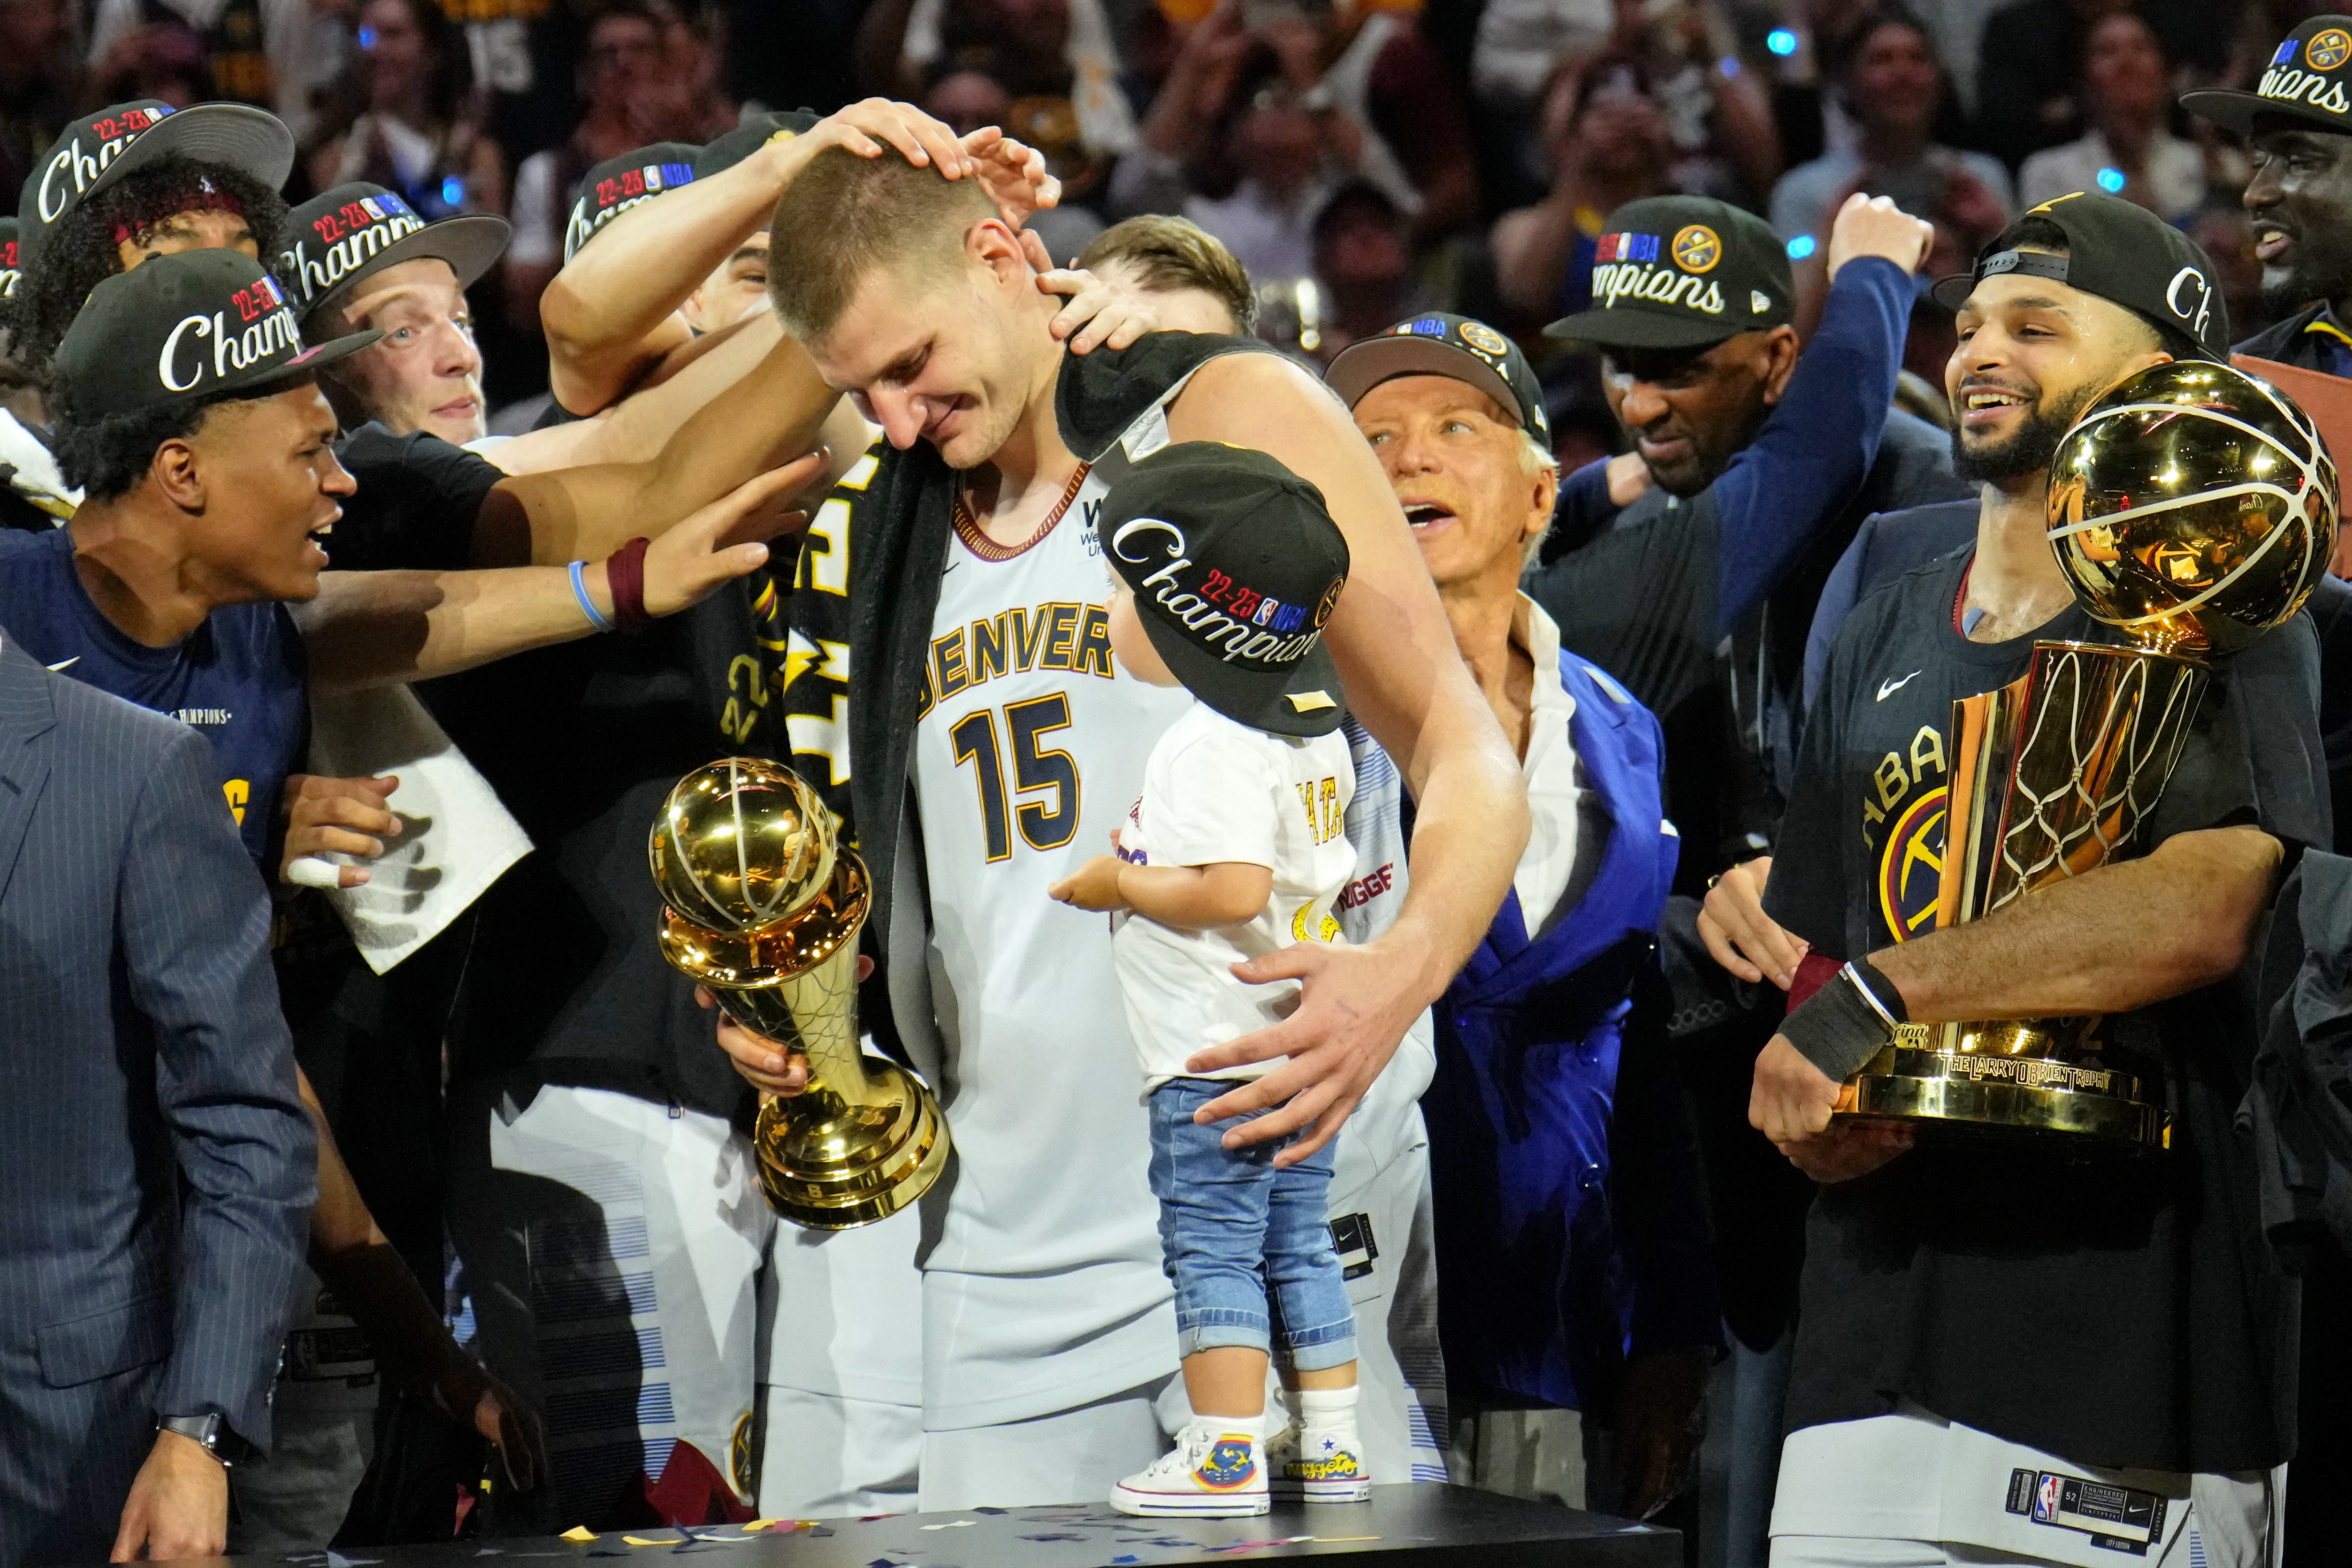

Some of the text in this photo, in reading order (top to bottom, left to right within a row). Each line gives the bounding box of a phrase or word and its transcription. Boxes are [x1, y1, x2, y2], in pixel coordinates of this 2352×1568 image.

[596, 169, 644, 206] 22-23
[314, 202, 371, 243] 22-23
[1413, 319, 1446, 336] NBA
[1200, 569, 1262, 618] 22-23
[949, 691, 1081, 865] 15
[1939, 1055, 1970, 1079] THE
[1970, 1056, 2017, 1081] LARRY
[2066, 1067, 2112, 1091] TROPHY
[2065, 1492, 2077, 1501] 52
